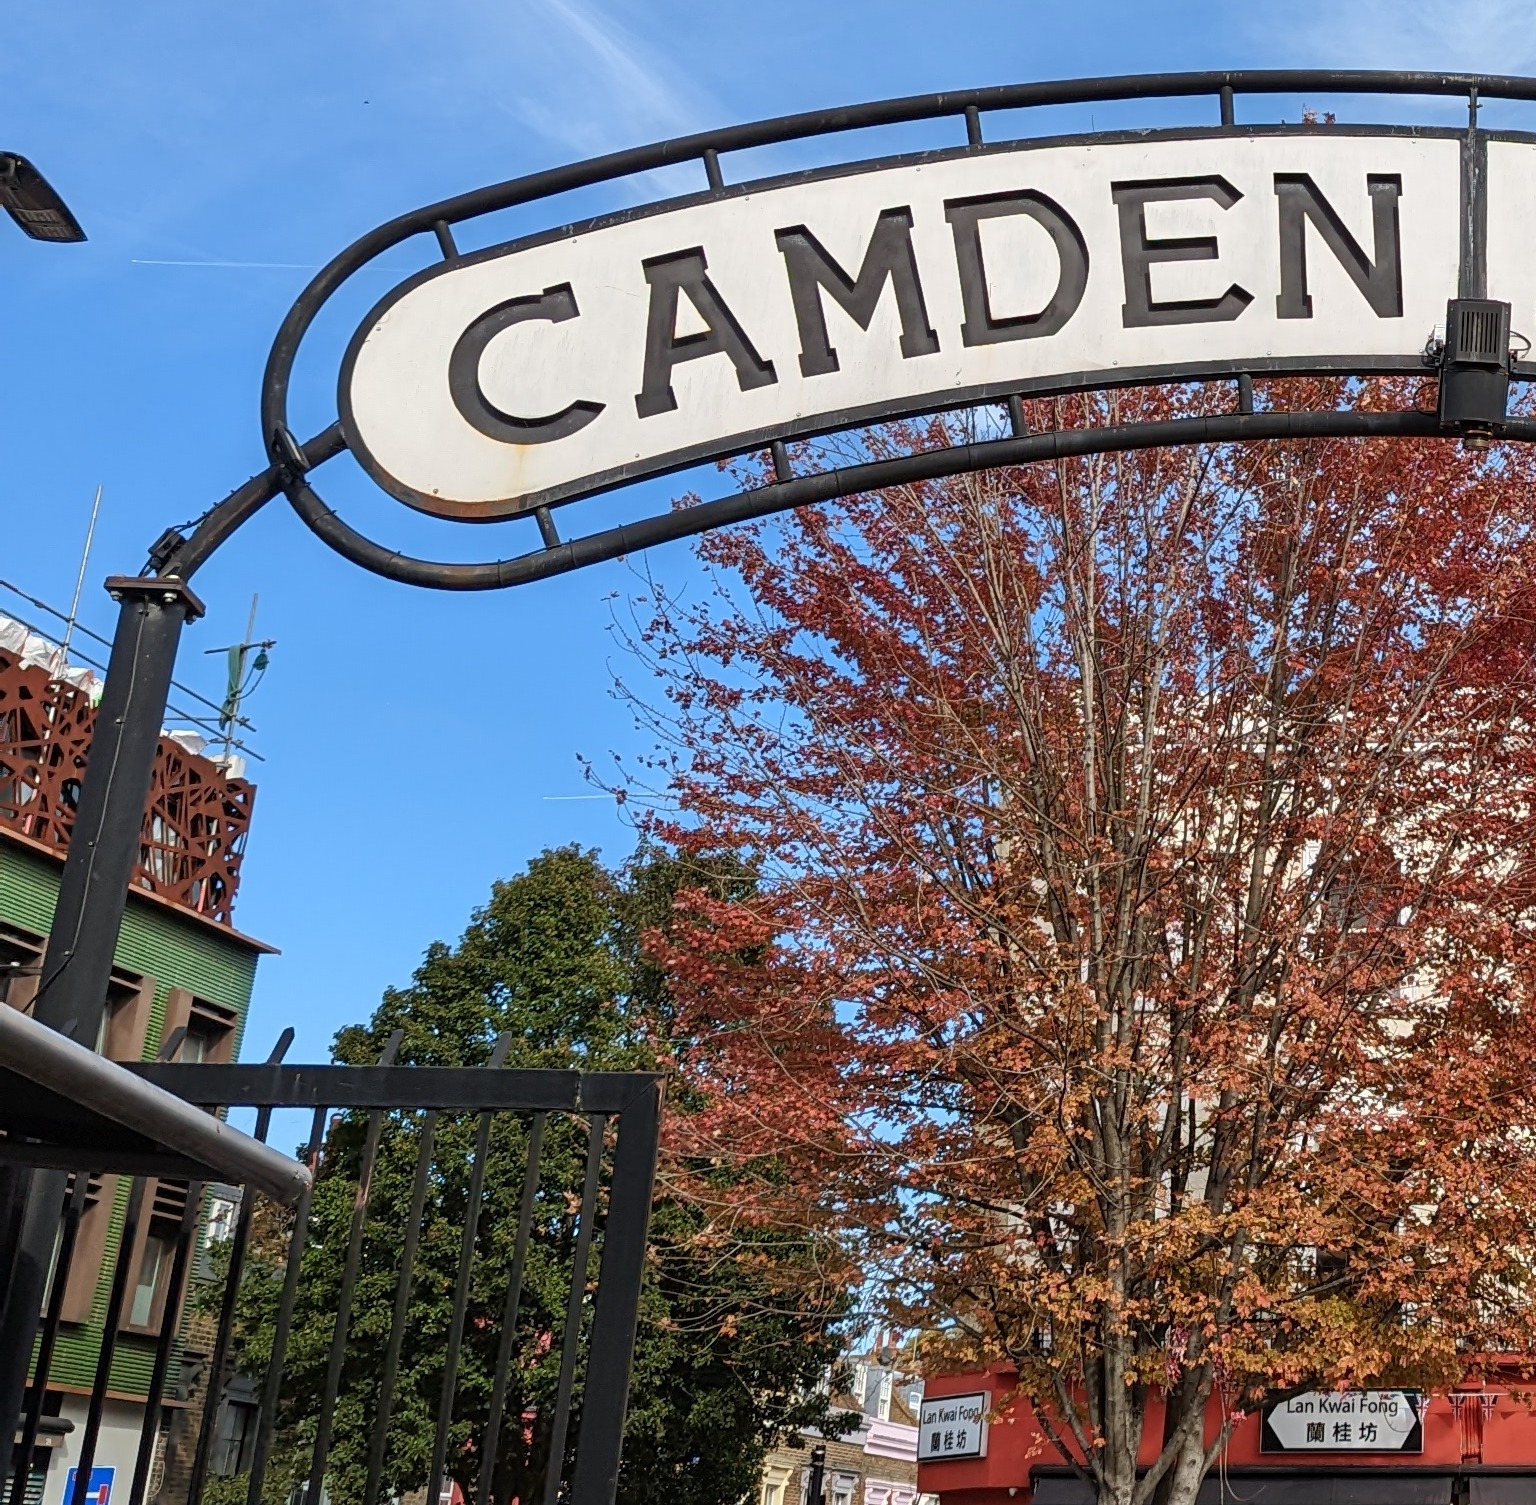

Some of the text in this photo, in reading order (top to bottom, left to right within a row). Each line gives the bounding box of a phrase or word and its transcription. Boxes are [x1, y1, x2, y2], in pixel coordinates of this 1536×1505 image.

[449, 173, 1403, 445] CAMDEN
[922, 1410, 937, 1425] Lan
[938, 1407, 958, 1423] Kwai
[1286, 1398, 1399, 1417] Lan Kwai Fong
[930, 1429, 968, 1453] 蘭桂坊
[1306, 1421, 1378, 1443] 蘭桂坊
